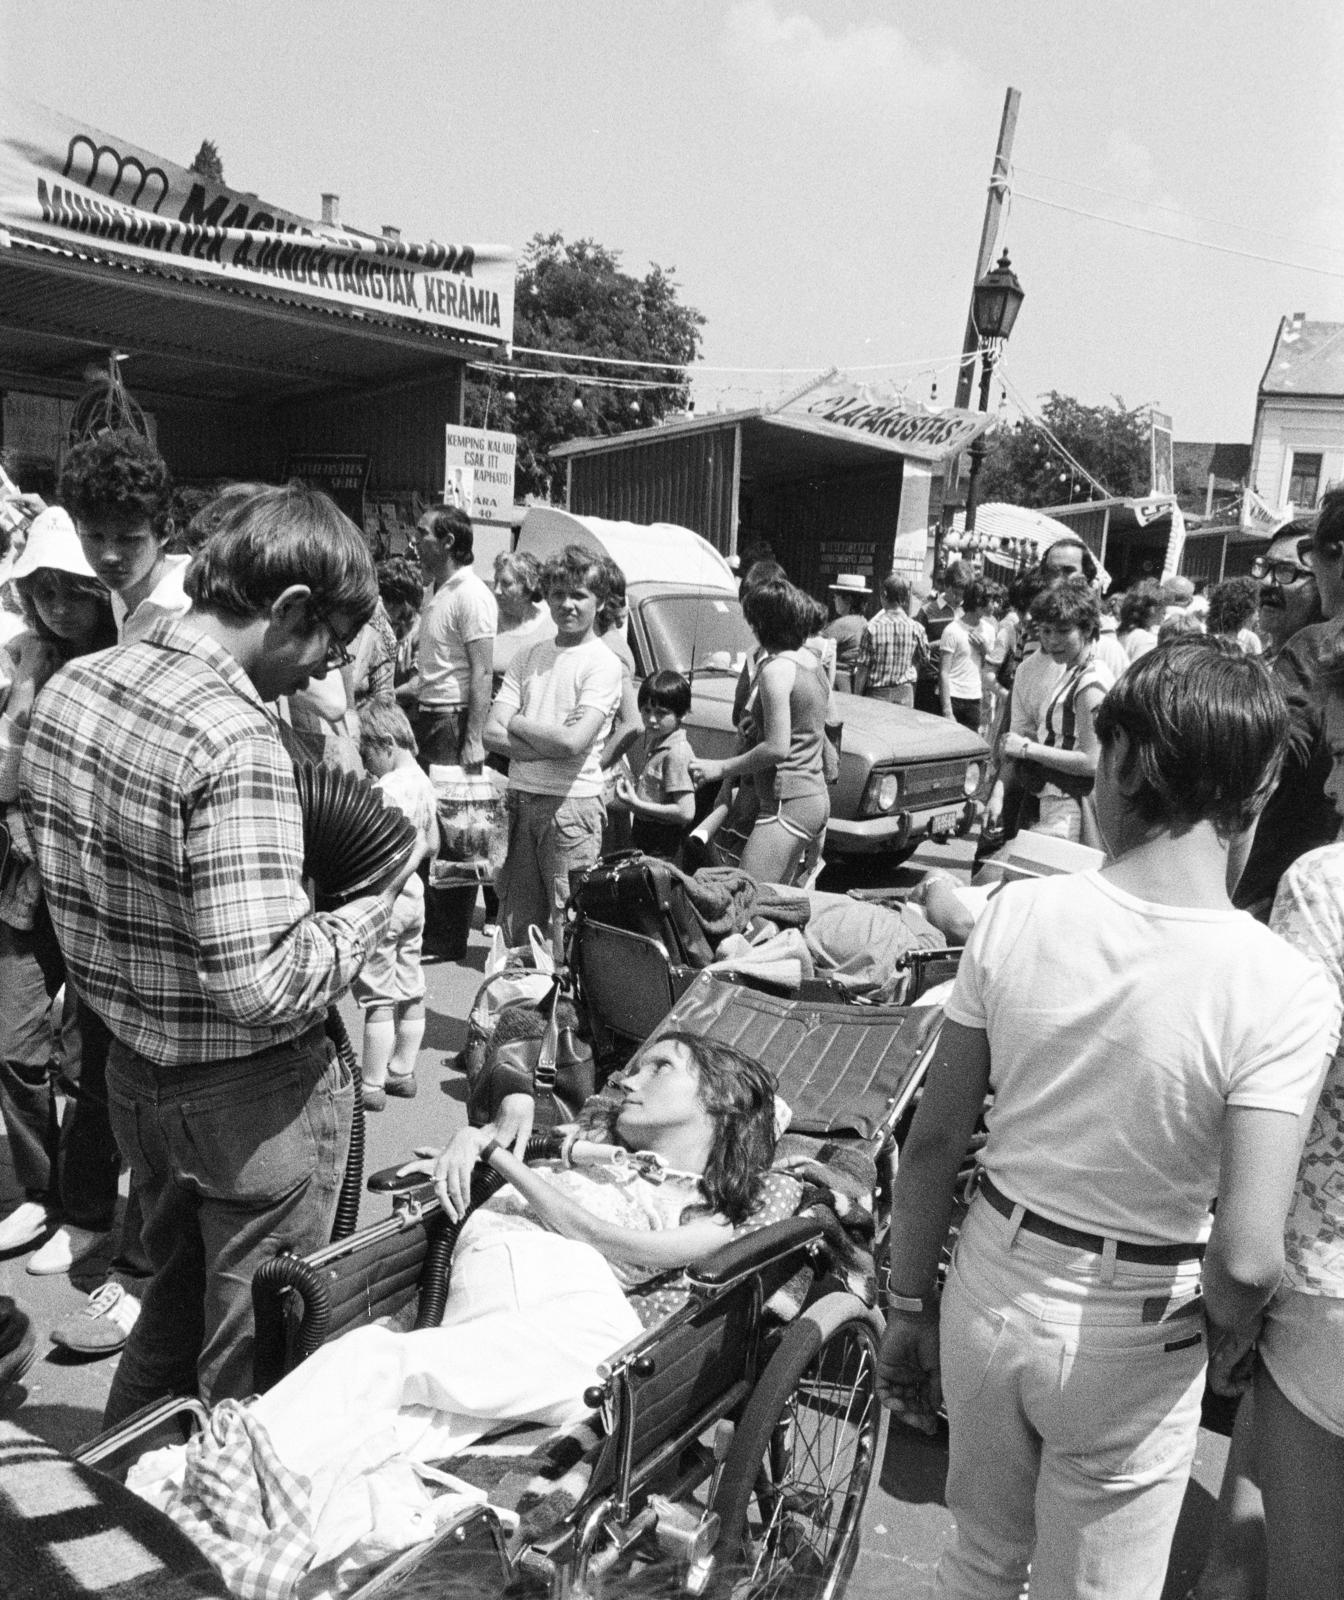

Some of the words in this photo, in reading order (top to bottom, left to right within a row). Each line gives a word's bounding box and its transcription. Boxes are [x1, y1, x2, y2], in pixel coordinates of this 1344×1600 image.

[423, 275, 501, 328] KERÁMIA
[447, 434, 485, 450] KEMPING
[487, 439, 516, 456] KALAUZ
[464, 451, 485, 467] CSAK
[488, 454, 499, 469] ITT
